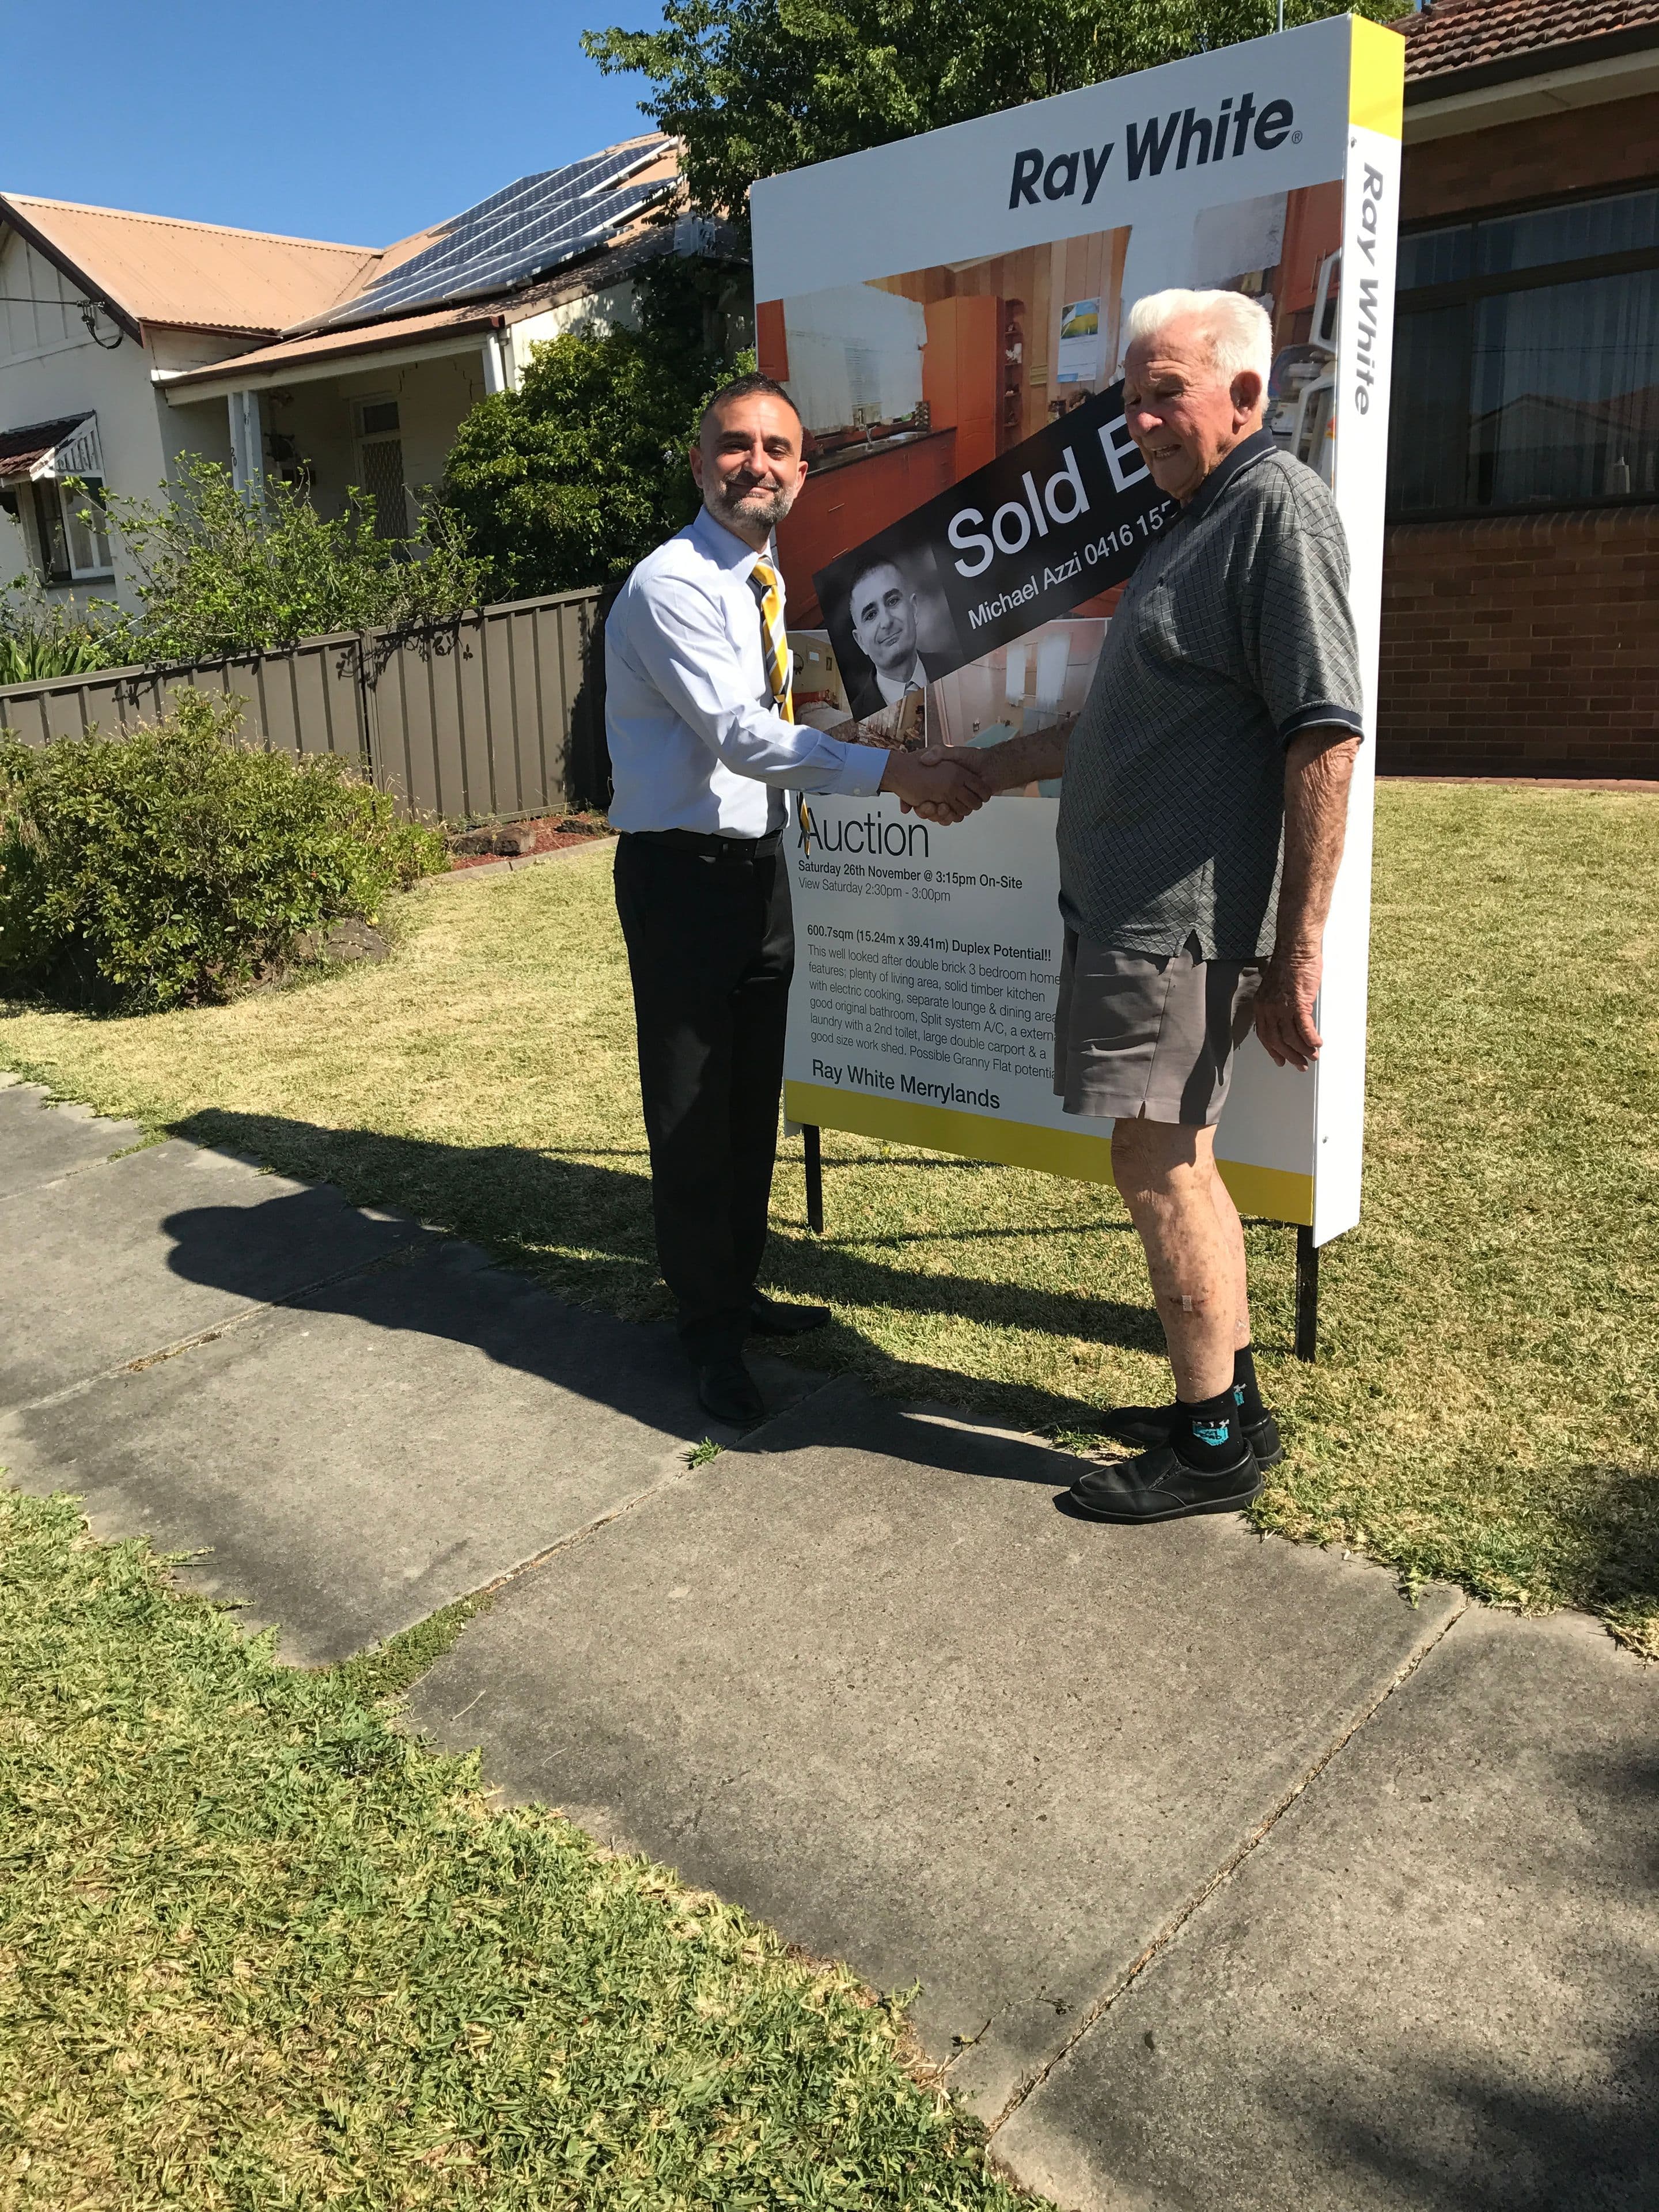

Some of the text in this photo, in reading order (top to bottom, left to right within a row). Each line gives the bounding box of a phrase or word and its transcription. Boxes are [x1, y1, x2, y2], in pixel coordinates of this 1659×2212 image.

[1009, 143, 1115, 209] Ray
[1354, 162, 1383, 415] Ray White
[948, 446, 1090, 577] Sold
[968, 576, 1039, 630] Michael
[1043, 552, 1083, 590] Azzi
[1085, 524, 1134, 565] 0416
[797, 808, 929, 857] Auction
[798, 859, 1022, 889] Saturday 26th November @ 3:15pm On-Site
[798, 877, 820, 889] View
[823, 878, 863, 896] Saturday
[866, 883, 902, 899] 2:30pm
[912, 887, 950, 903] 3:00pm
[808, 924, 1051, 961] 600.7sqm (15.24m x 39.41m) Duplex Potential!!
[808, 944, 1060, 985] This well looked after double brick 3 bedroom home
[850, 968, 876, 983] plenty
[880, 971, 888, 982] of
[891, 972, 914, 988] living
[917, 978, 941, 990] area,
[945, 980, 967, 993] solid
[971, 982, 1003, 997] timber
[1007, 986, 1045, 1002] kitchen
[809, 980, 827, 991] with
[830, 982, 861, 996] electric
[864, 988, 903, 1004] cooking,
[907, 994, 949, 1008] separate
[952, 998, 986, 1015] lounge
[989, 1003, 996, 1014] &
[1000, 1005, 1031, 1022] dining
[810, 998, 832, 1009] good
[835, 1001, 866, 1014] original
[869, 1005, 917, 1023] bathroom,
[921, 1012, 942, 1026] Split
[945, 1018, 980, 1031] system
[984, 1021, 1007, 1036] A/C,
[1010, 1027, 1017, 1036] a
[810, 1013, 1046, 1059] laundry with a 2nd toilet, large double carport & a
[811, 1032, 834, 1043] good
[836, 1035, 853, 1046] size
[856, 1039, 878, 1051] work
[881, 1041, 906, 1055] shed.
[910, 1046, 950, 1062] Possible
[953, 1052, 990, 1071] Granny
[993, 1058, 1012, 1073] Flat
[812, 1059, 1000, 1109] Ray White Merrylands
